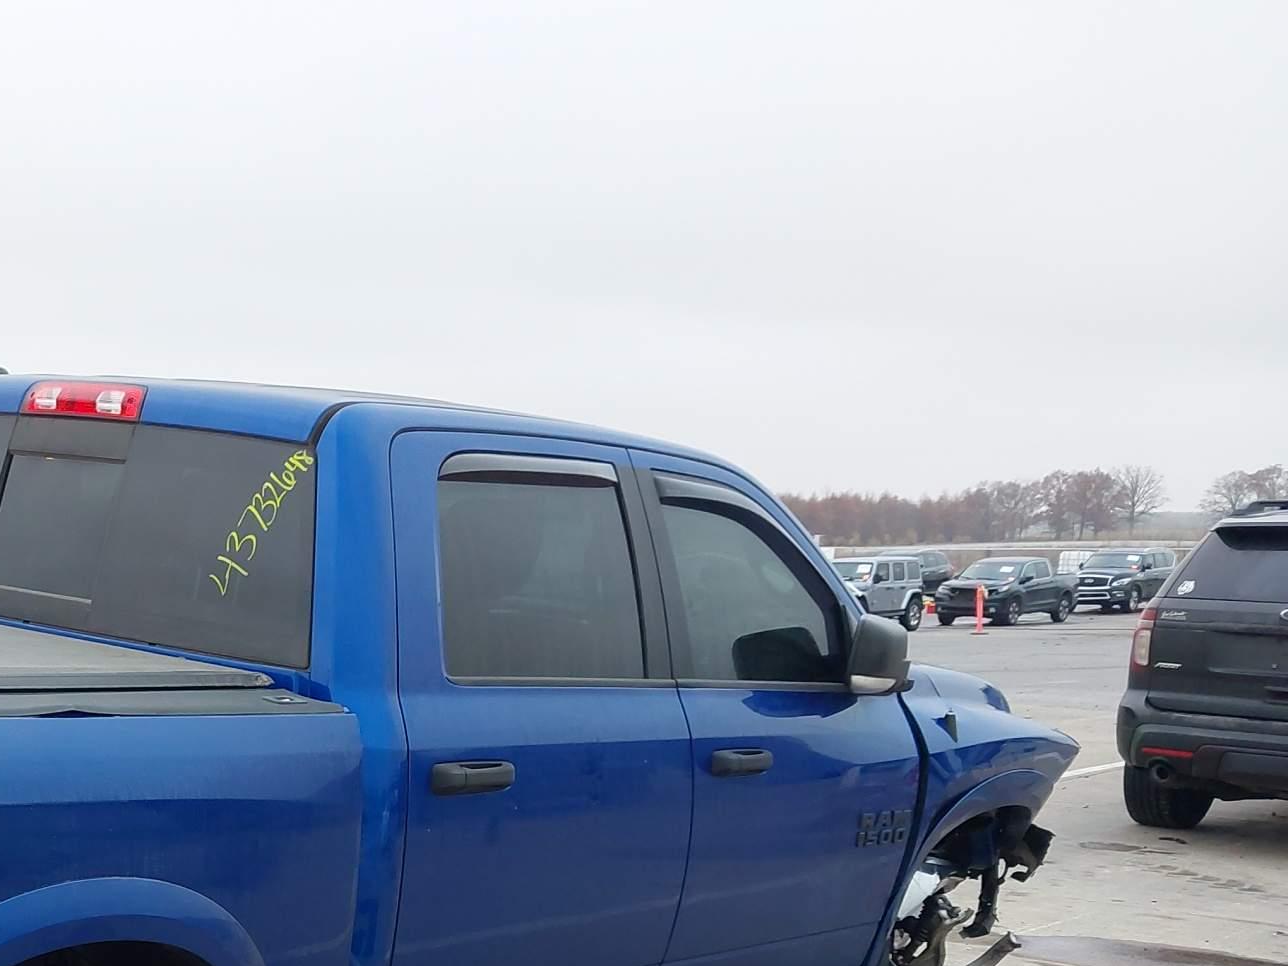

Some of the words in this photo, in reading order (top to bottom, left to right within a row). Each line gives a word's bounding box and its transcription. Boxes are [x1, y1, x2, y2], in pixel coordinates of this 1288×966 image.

[209, 449, 314, 596] 43732648
[859, 809, 912, 830] RAM
[855, 828, 907, 848] 1500
